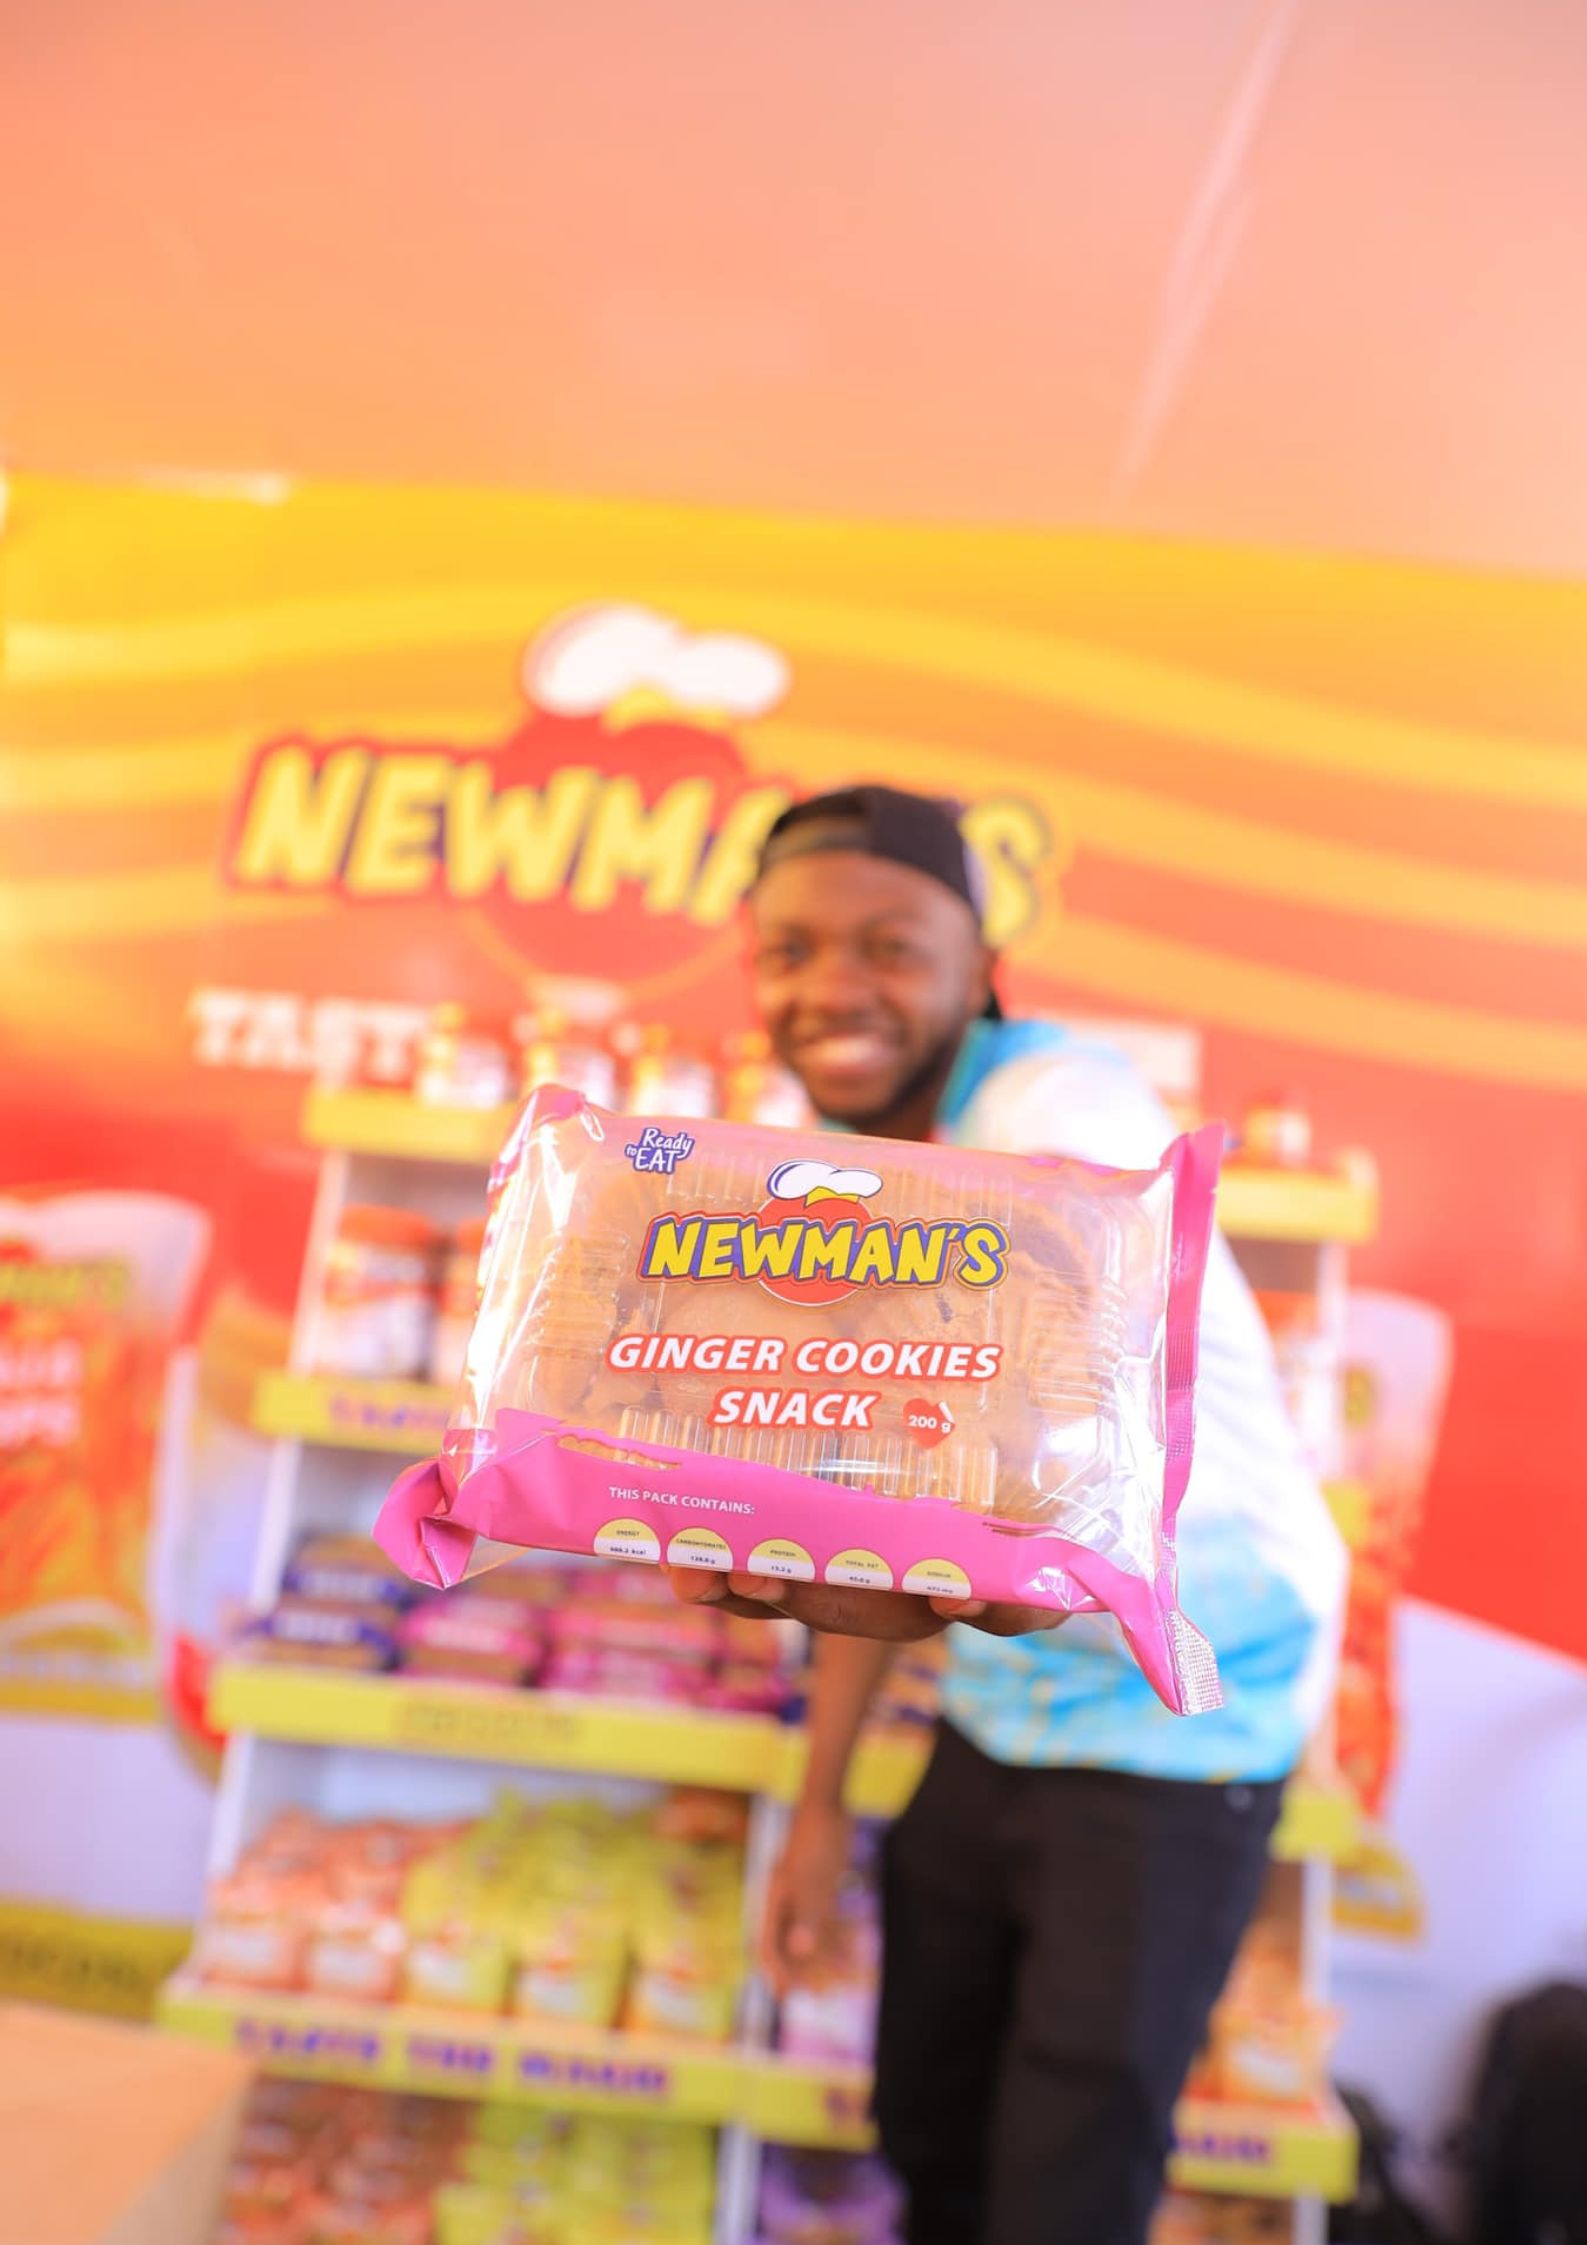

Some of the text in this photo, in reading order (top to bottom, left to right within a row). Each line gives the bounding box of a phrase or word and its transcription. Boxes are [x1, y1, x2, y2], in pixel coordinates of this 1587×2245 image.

[232, 742, 1046, 946] NEWMS
[625, 1145, 682, 1173] to EAT
[643, 1127, 693, 1160] Ready
[644, 1217, 1002, 1287] NEWMAN'S
[609, 1336, 1001, 1379] GINGER COOKIES
[713, 1390, 877, 1428] SNACK
[908, 1414, 952, 1435] 200 g
[608, 1486, 756, 1515] THIS PACK CONTAINS:
